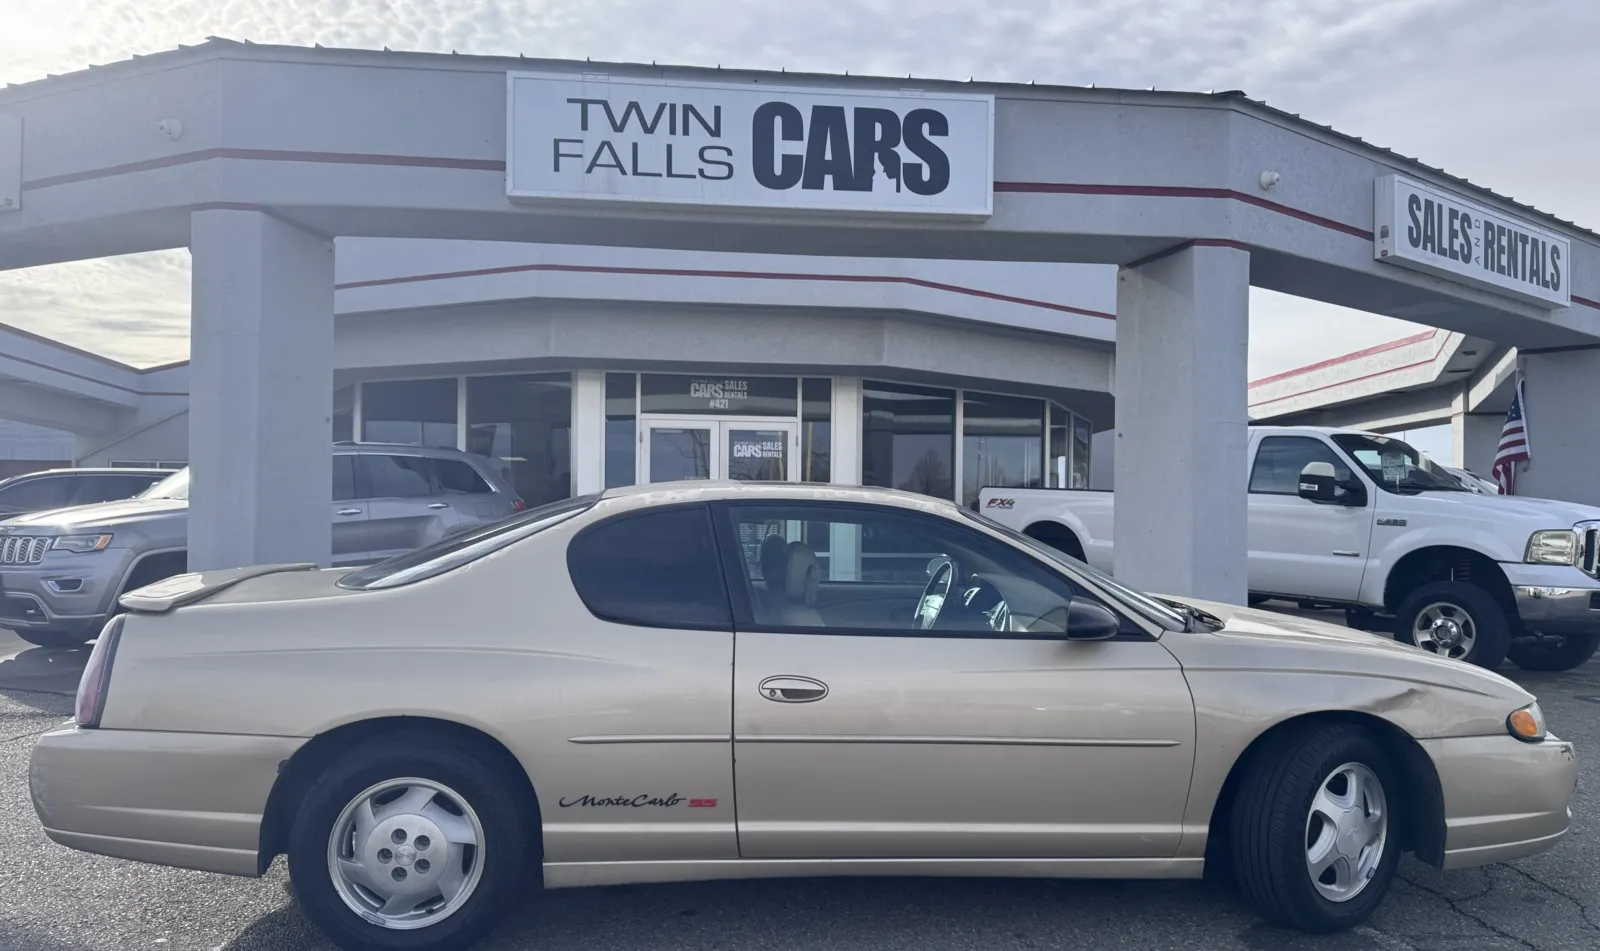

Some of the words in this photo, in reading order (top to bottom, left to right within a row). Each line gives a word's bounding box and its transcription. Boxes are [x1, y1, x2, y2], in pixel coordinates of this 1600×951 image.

[566, 97, 722, 138] TWIN
[752, 101, 950, 196] CARS
[553, 137, 734, 181] FALLS
[1407, 193, 1473, 264] SALES
[1483, 219, 1561, 292] RENTALS
[690, 383, 723, 398] CARS
[724, 380, 748, 390] SALES
[724, 391, 748, 399] RENTALS
[709, 399, 729, 409] #421
[734, 444, 762, 458] CARS
[762, 441, 782, 450] SALES
[987, 498, 1015, 506] FX4
